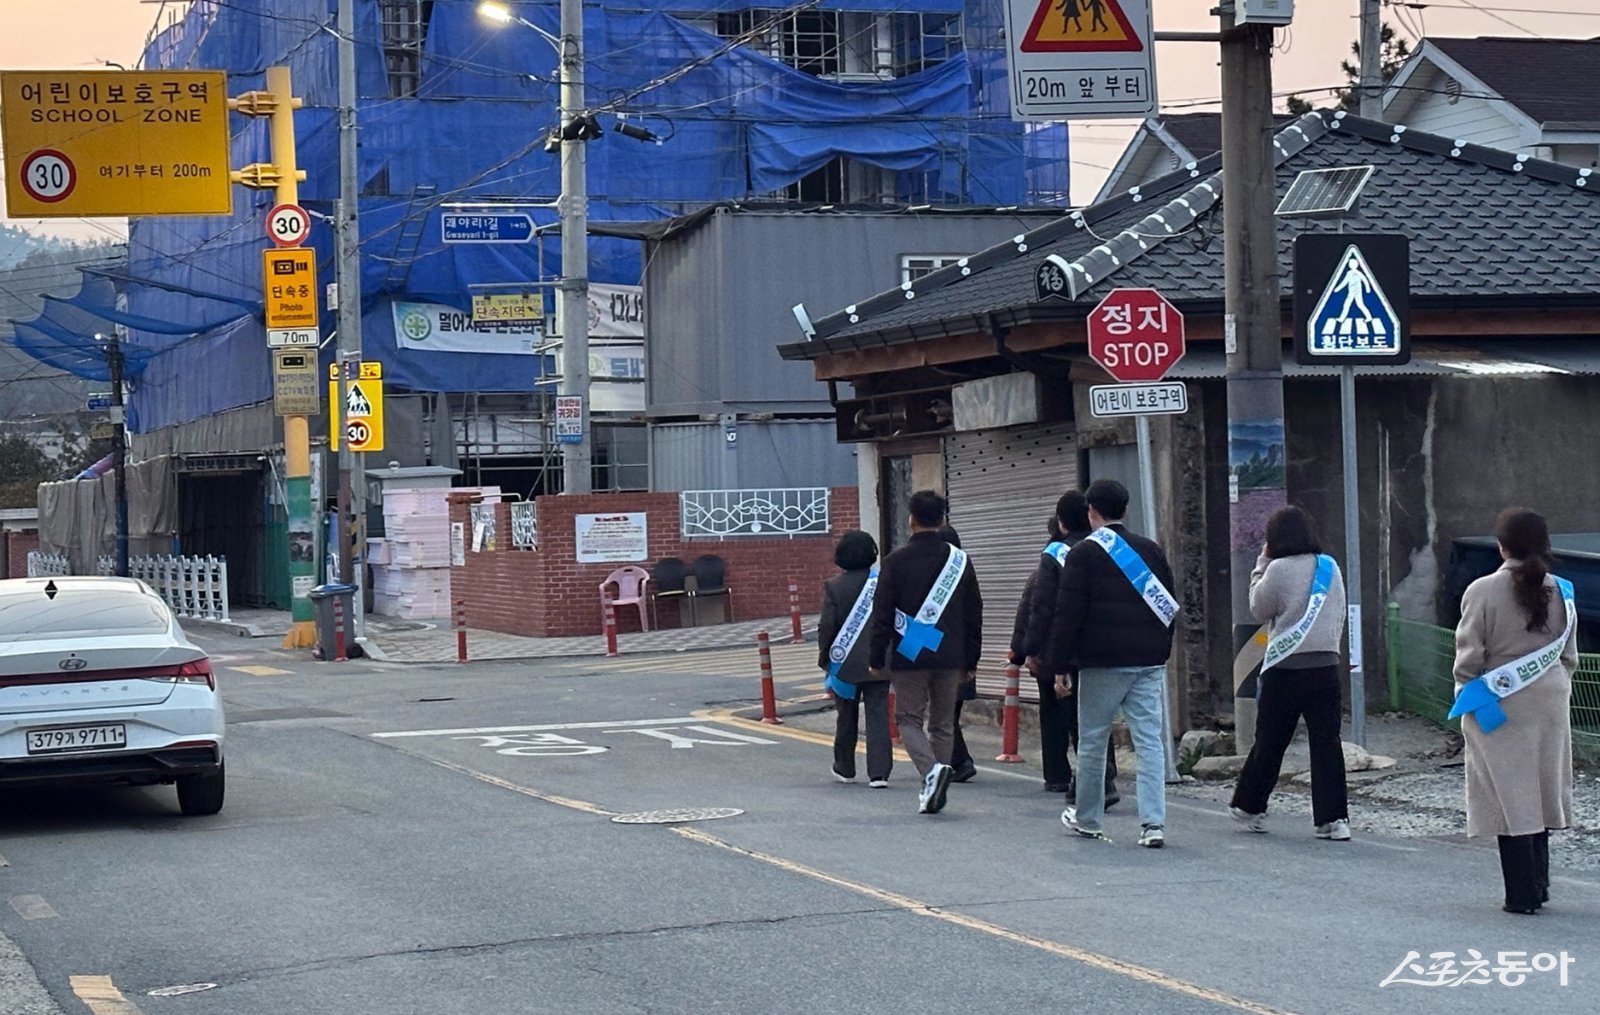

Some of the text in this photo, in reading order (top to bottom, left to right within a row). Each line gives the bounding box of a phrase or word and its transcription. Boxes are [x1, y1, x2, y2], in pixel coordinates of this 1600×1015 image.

[20, 81, 209, 104] 어린이보호구역
[1027, 77, 1065, 98] 20m
[30, 108, 202, 124] SCHOOL ZONE
[35, 163, 64, 190] 30
[99, 163, 212, 179] 여기부터 200m
[276, 216, 300, 235] 30
[272, 284, 310, 299] 단속중
[279, 303, 304, 311] Photo
[476, 305, 526, 320] 단속지역
[1101, 303, 1168, 335] 정지
[282, 332, 310, 344] 70m
[1320, 334, 1388, 350] 횡단보도
[1103, 342, 1170, 367] STOP
[1097, 388, 1181, 411] 어린이 보호구역
[558, 408, 580, 419] 귀갓길
[348, 425, 367, 441] 30
[568, 425, 581, 434] 112
[1516, 661, 1541, 683] 미래
[19, 686, 128, 697] AVANTE
[79, 728, 117, 744] 9711
